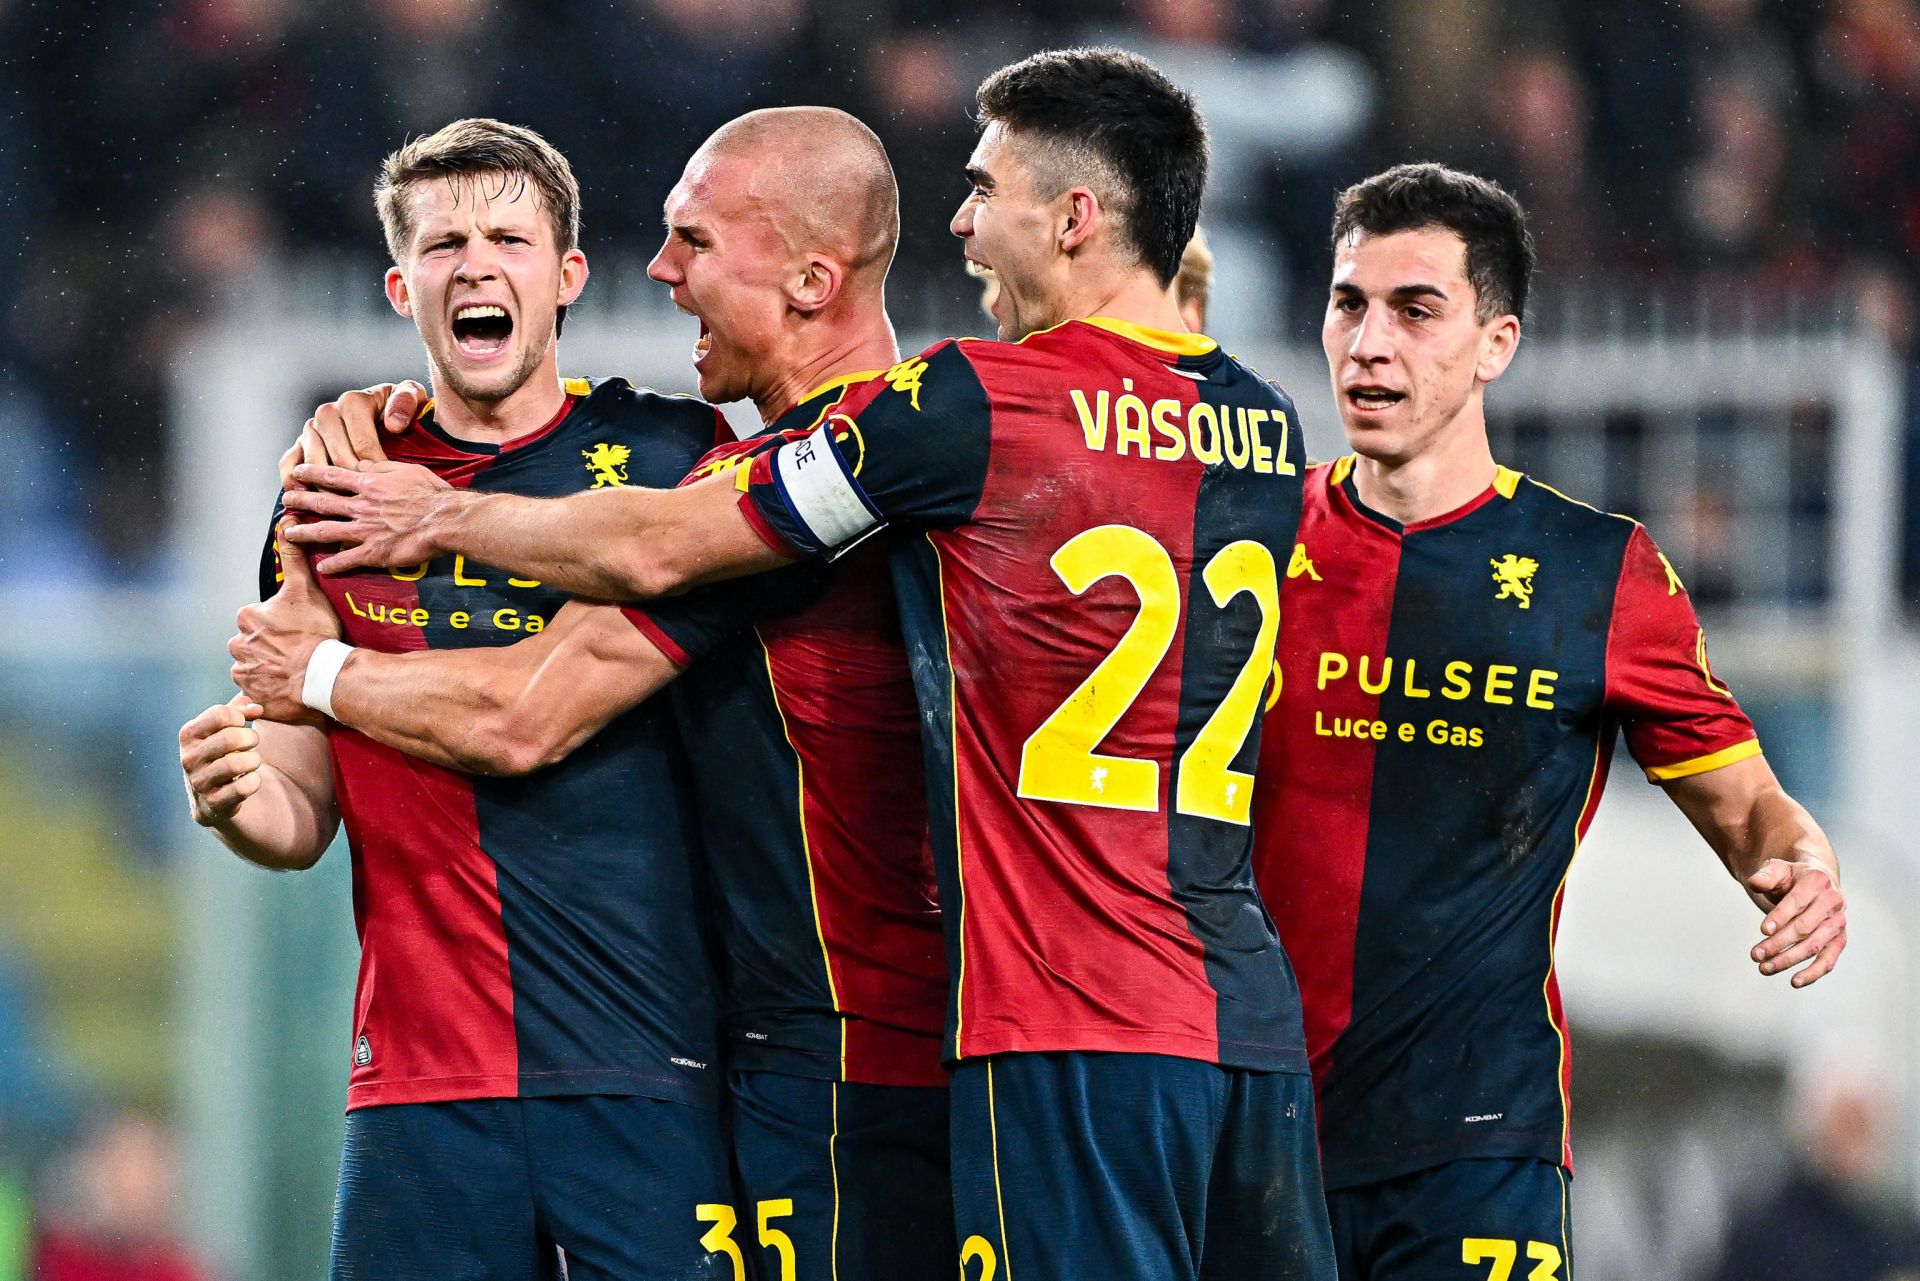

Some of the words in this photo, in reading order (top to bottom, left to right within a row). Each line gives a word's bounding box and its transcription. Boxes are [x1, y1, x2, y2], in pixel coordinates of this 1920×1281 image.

[345, 592, 430, 627] Luce
[449, 610, 471, 629] e
[492, 607, 546, 633] Ga
[1017, 524, 1280, 827] 22
[1316, 651, 1559, 710] PULSEE
[1315, 711, 1388, 741] Luce
[1398, 722, 1416, 742] e
[1426, 719, 1484, 748] Gas
[745, 1032, 769, 1040] KOMBAT
[670, 1056, 707, 1069] KOMBAT
[1465, 1112, 1504, 1123] KOMBAT
